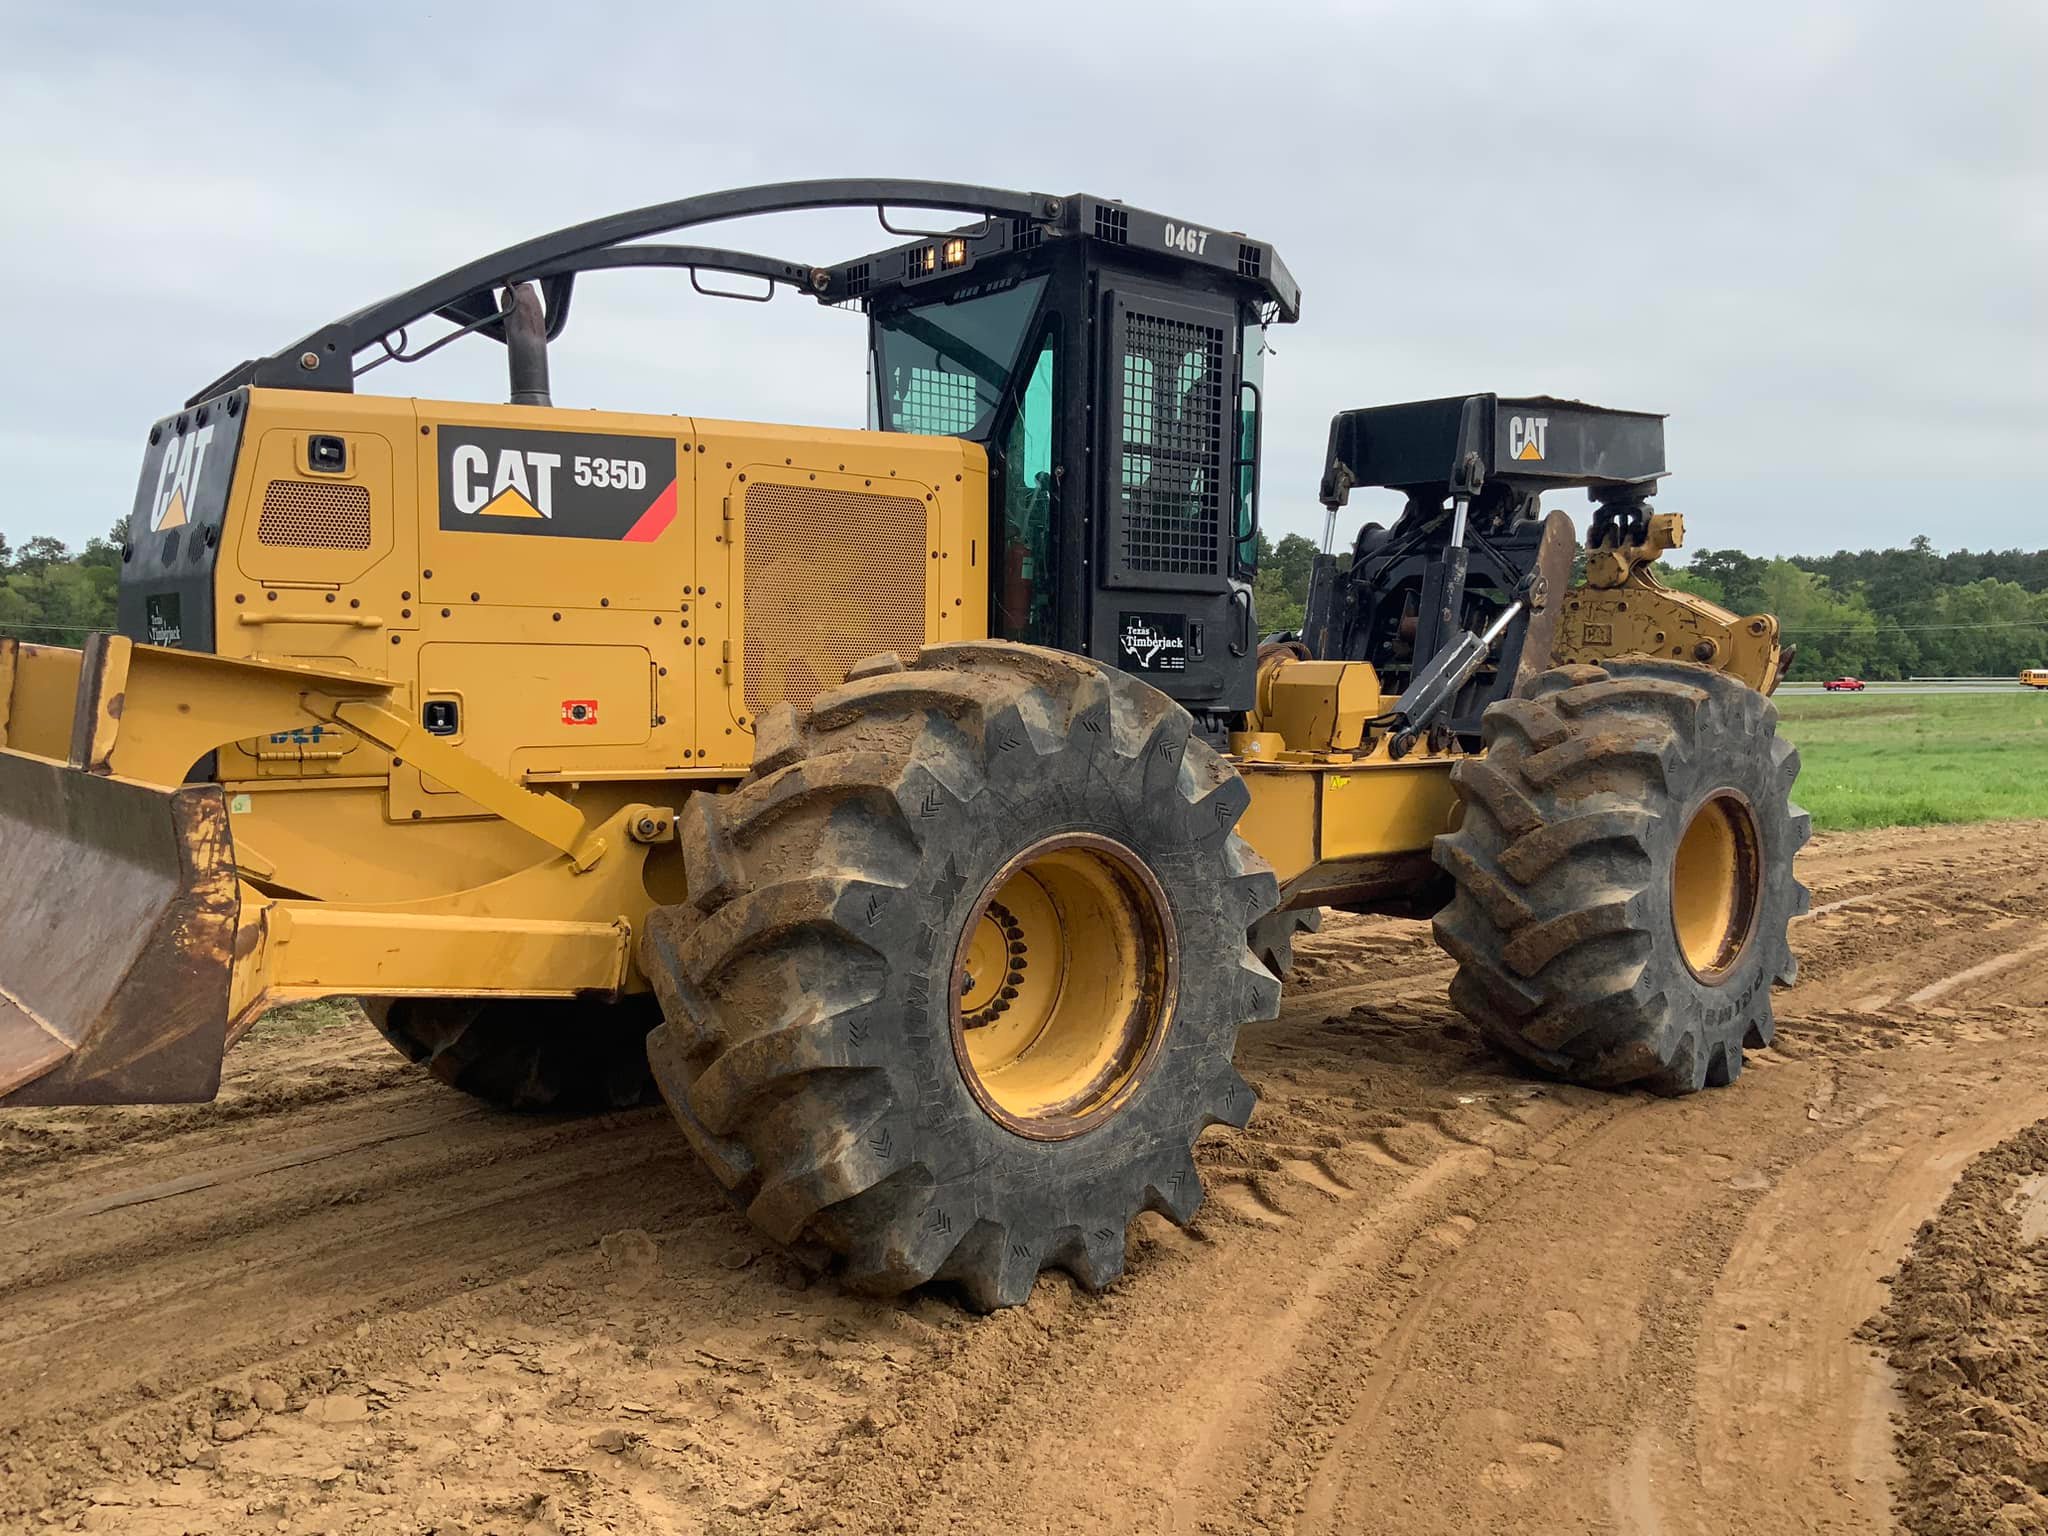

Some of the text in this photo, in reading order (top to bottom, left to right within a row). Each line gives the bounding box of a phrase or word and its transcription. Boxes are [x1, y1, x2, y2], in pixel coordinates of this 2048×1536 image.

[1165, 223, 1208, 255] 0467
[1509, 415, 1549, 460] CAT
[150, 423, 215, 533] CAT
[452, 444, 647, 519] CAT 535D
[1126, 626, 1150, 635] Texas
[1126, 635, 1184, 650] Timberjack
